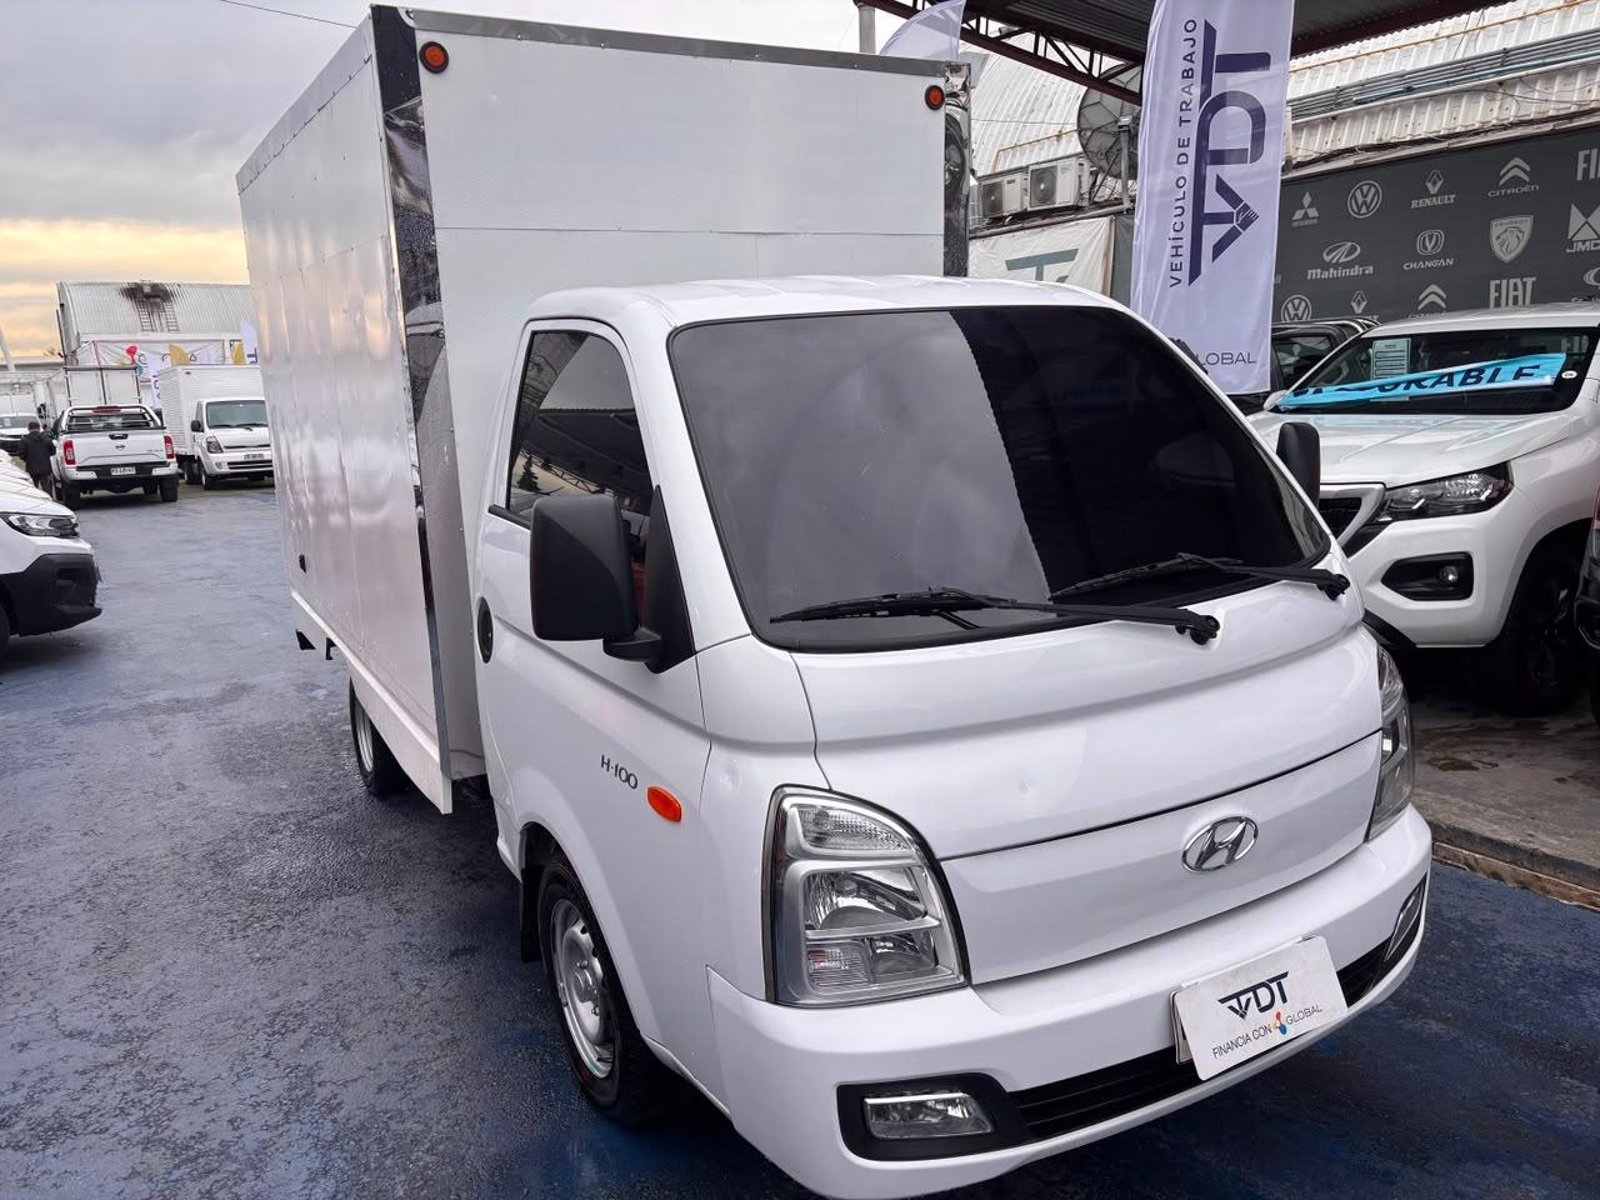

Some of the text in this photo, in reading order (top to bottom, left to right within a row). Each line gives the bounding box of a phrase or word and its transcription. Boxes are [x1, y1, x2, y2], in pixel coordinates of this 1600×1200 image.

[1179, 19, 1197, 127] TRABAJO
[1176, 137, 1191, 165] DE
[1577, 148, 1600, 181] FI
[1411, 194, 1456, 208] RENAULT
[1307, 265, 1373, 280] Mahindra
[1403, 258, 1454, 270] CHANGAN
[1489, 277, 1537, 309] FIAT
[1212, 1004, 1323, 1059] FINANCIA CON GLOBAL
